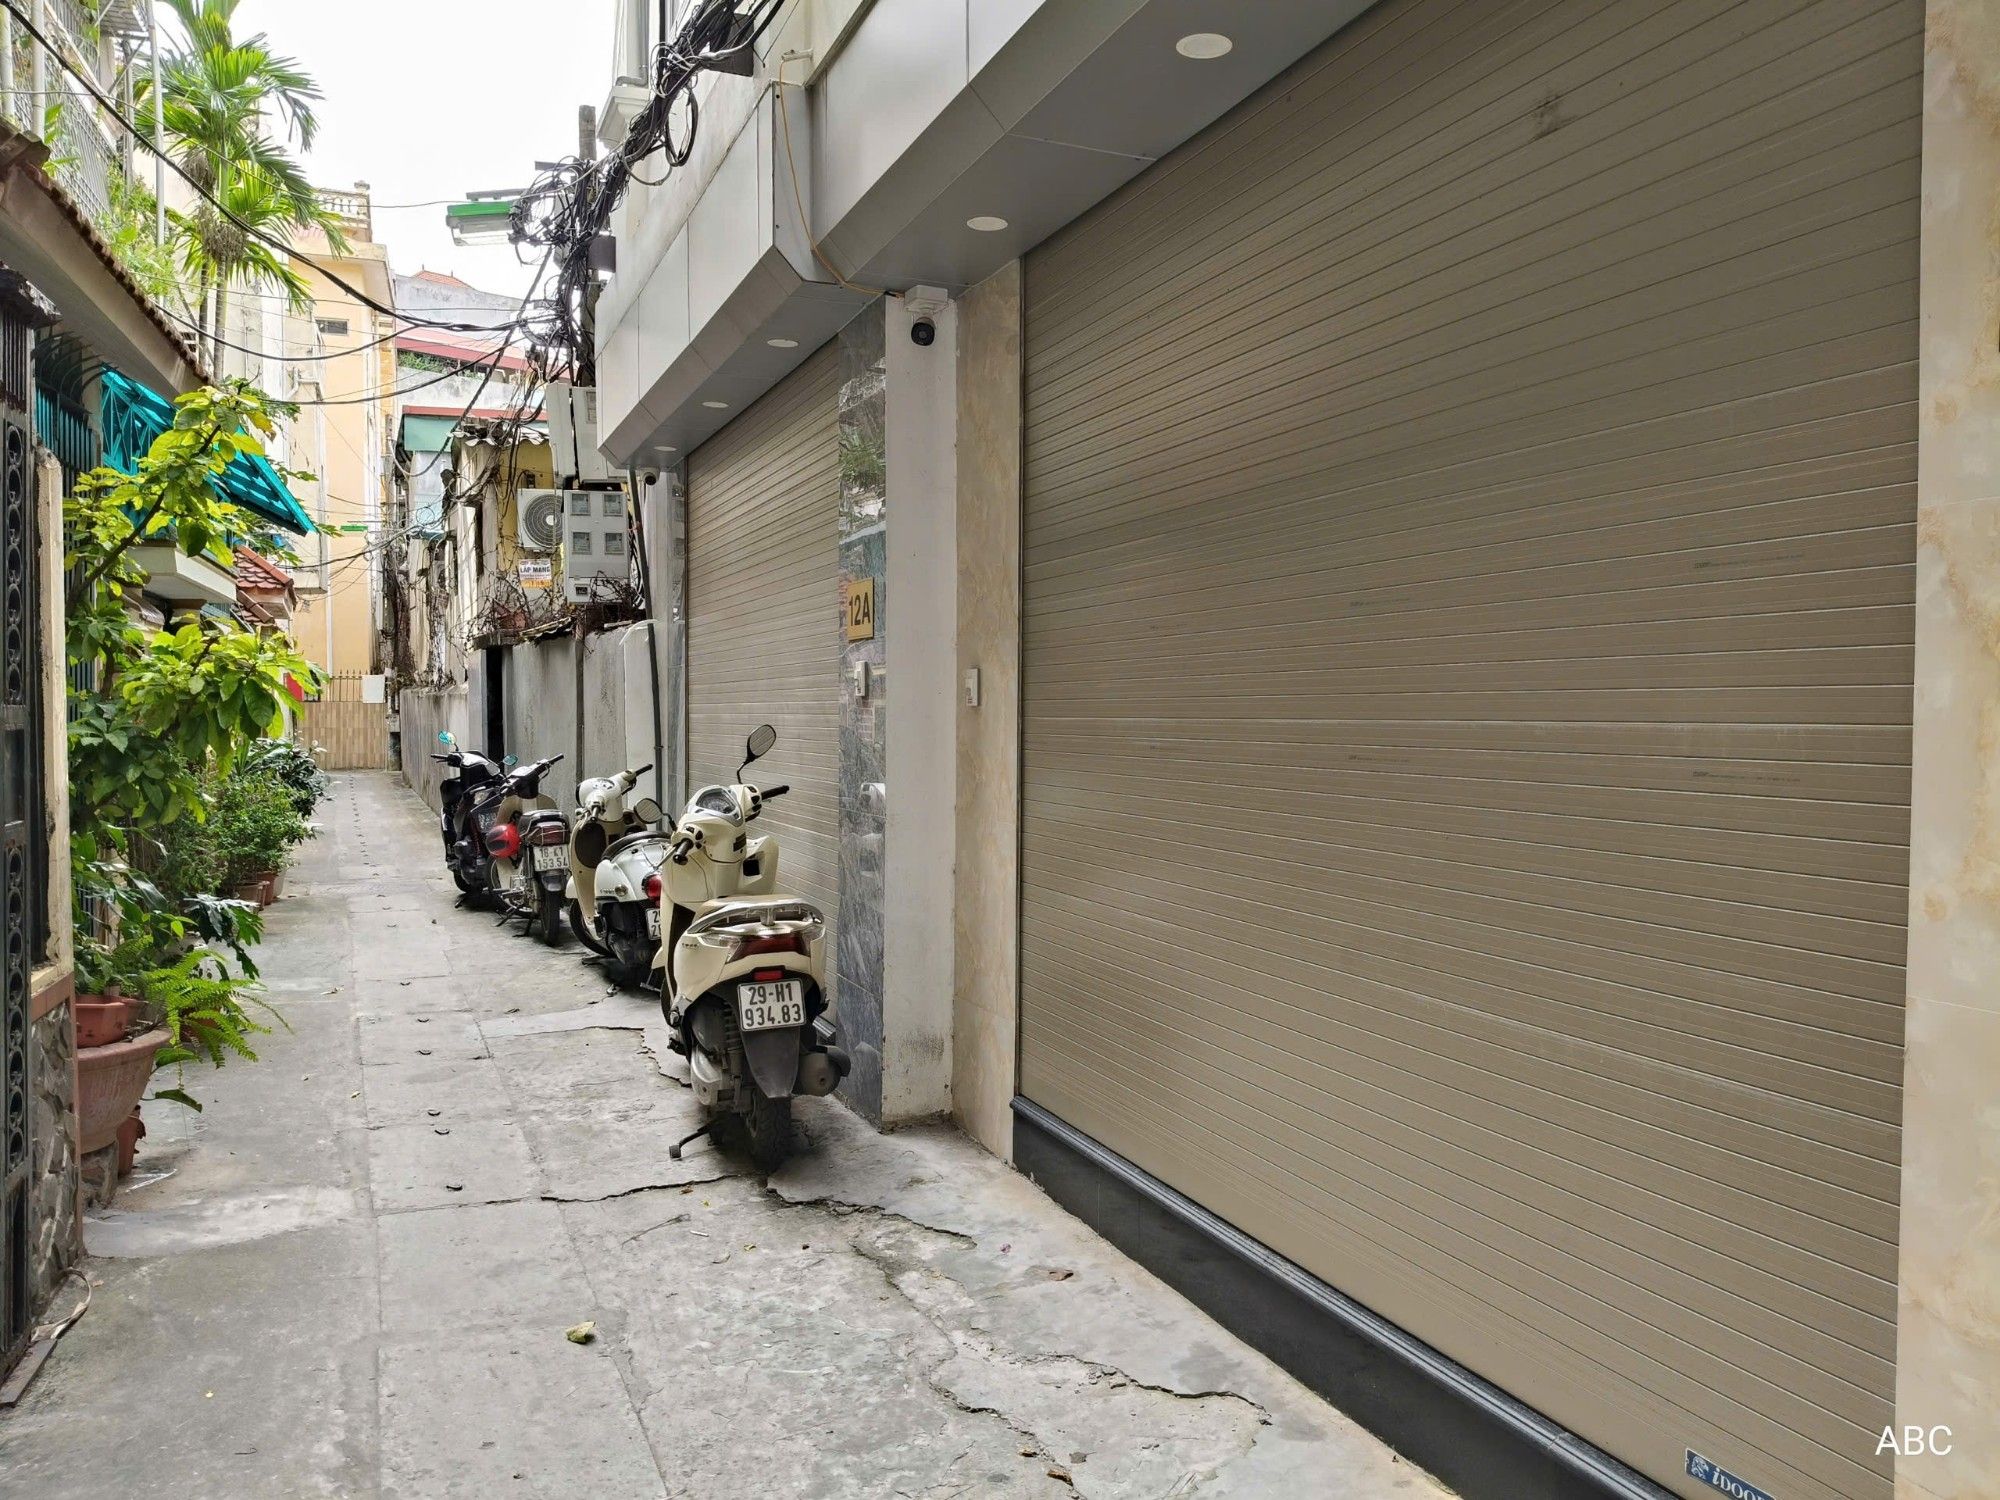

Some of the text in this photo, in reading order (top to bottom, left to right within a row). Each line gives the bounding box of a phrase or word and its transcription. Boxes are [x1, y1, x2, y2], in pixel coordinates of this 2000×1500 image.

[849, 592, 871, 626] 12A
[748, 983, 793, 1006] 29-H1
[745, 1003, 801, 1027] 934.83
[1712, 1467, 1764, 1500] iDOO
